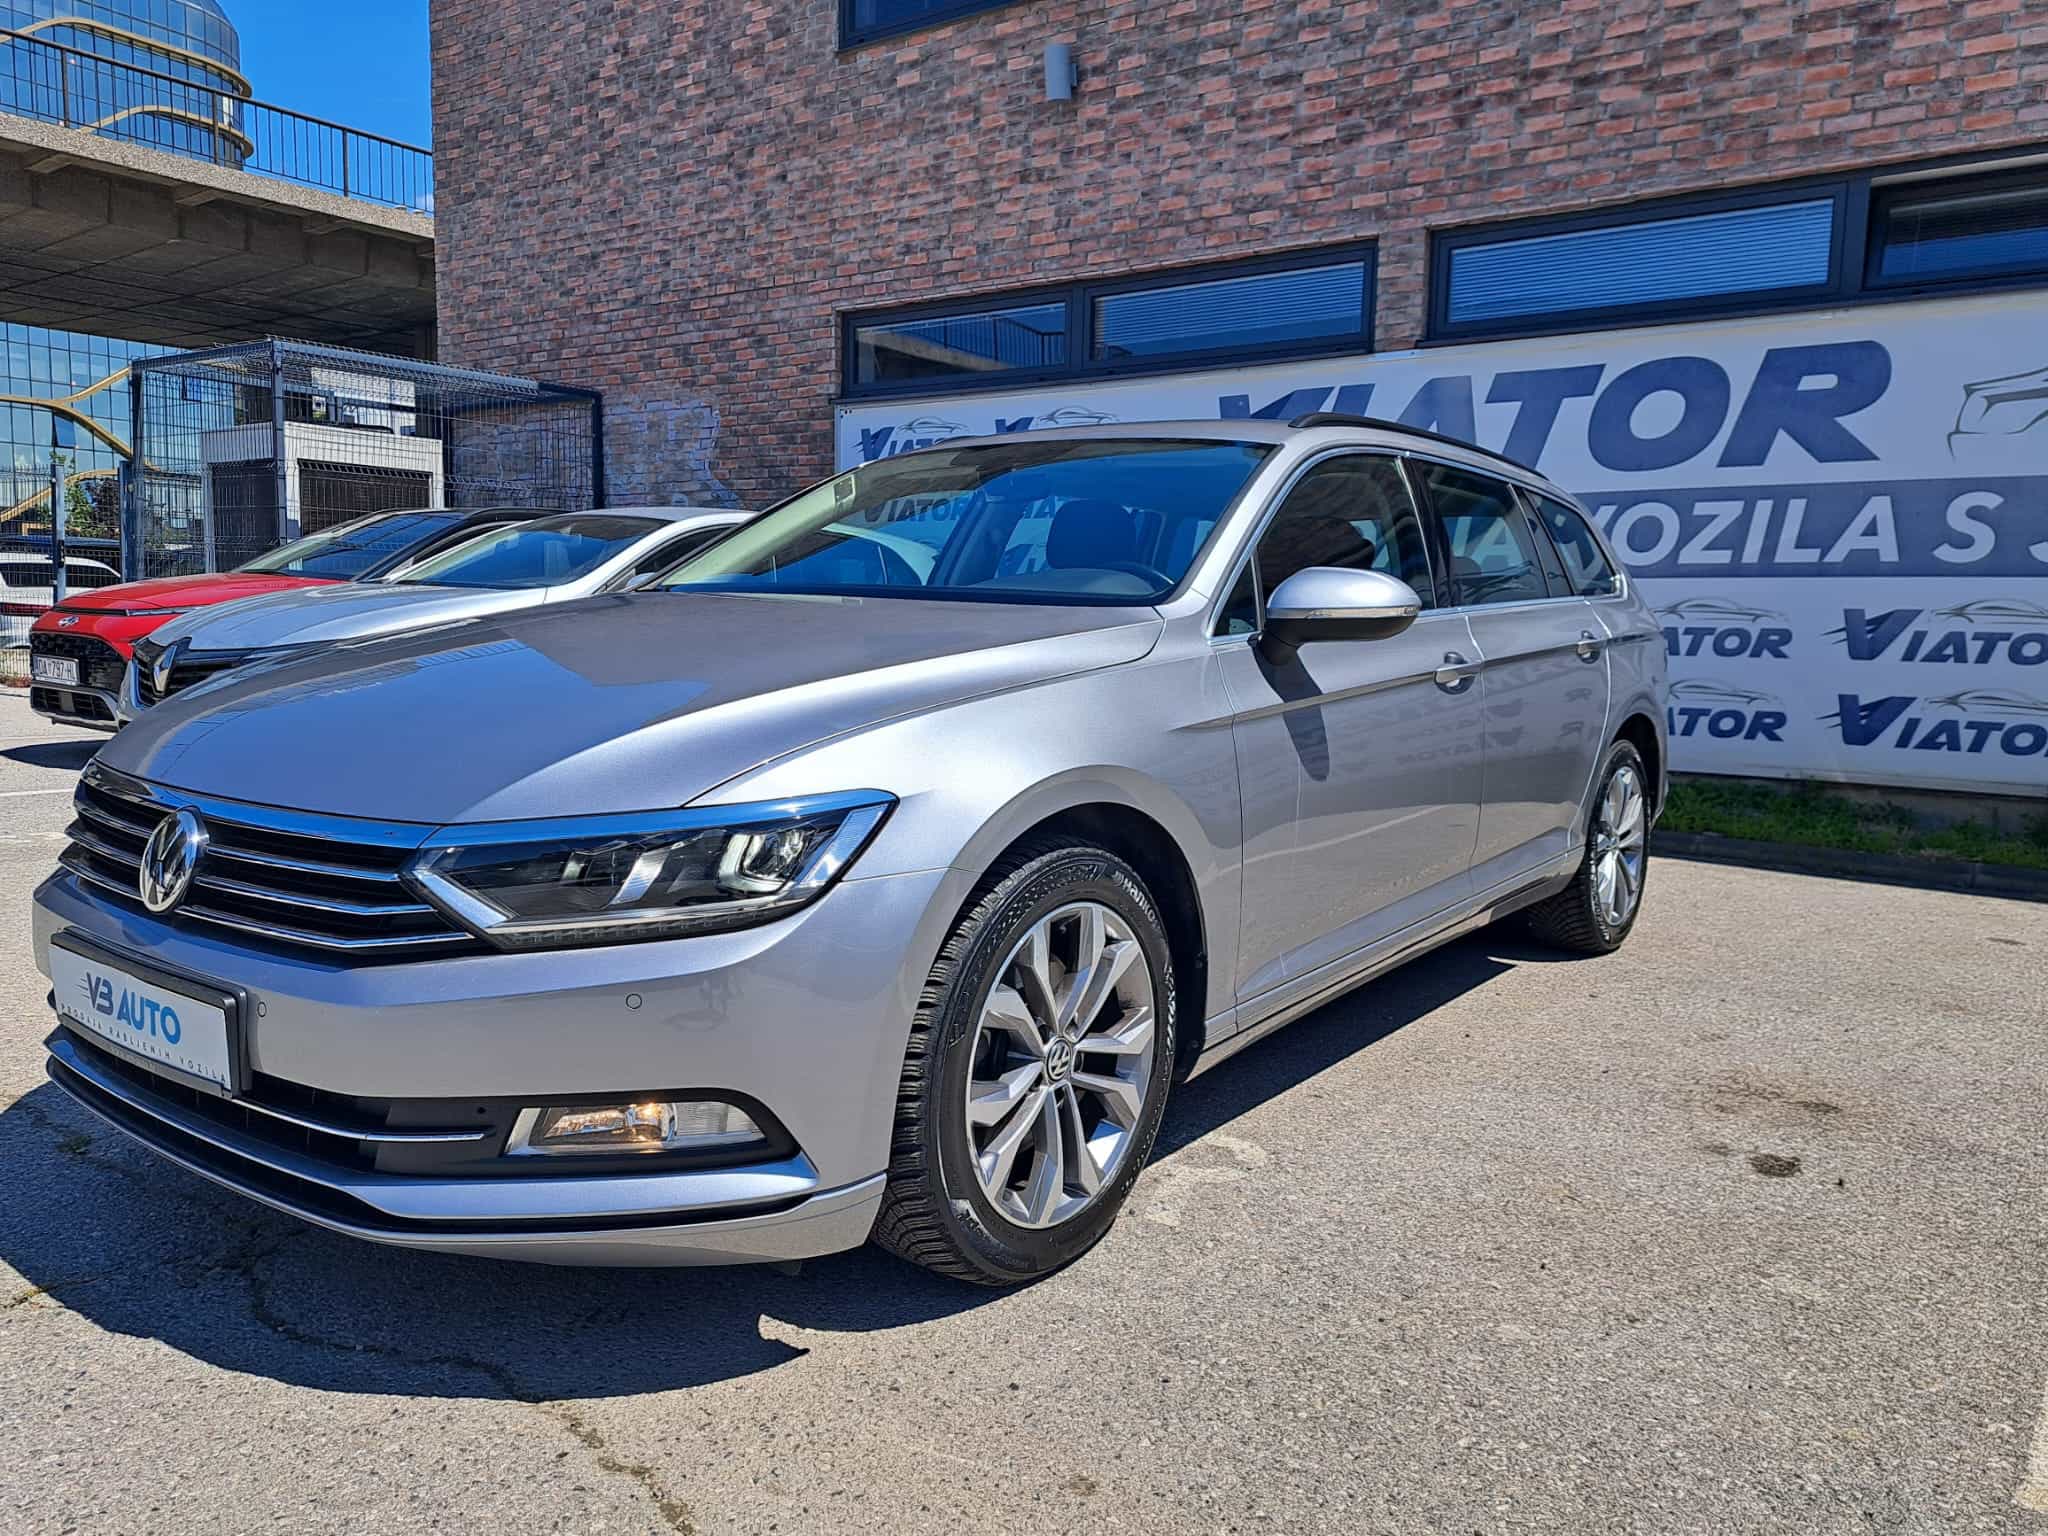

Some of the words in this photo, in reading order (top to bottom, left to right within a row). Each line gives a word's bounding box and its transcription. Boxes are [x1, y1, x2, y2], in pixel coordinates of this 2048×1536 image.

[1220, 340, 1892, 473] ATOR
[1932, 491, 2005, 563] S
[1842, 608, 2048, 666] VIATO
[1837, 693, 2048, 757] VIATO
[116, 987, 181, 1045] AUTO
